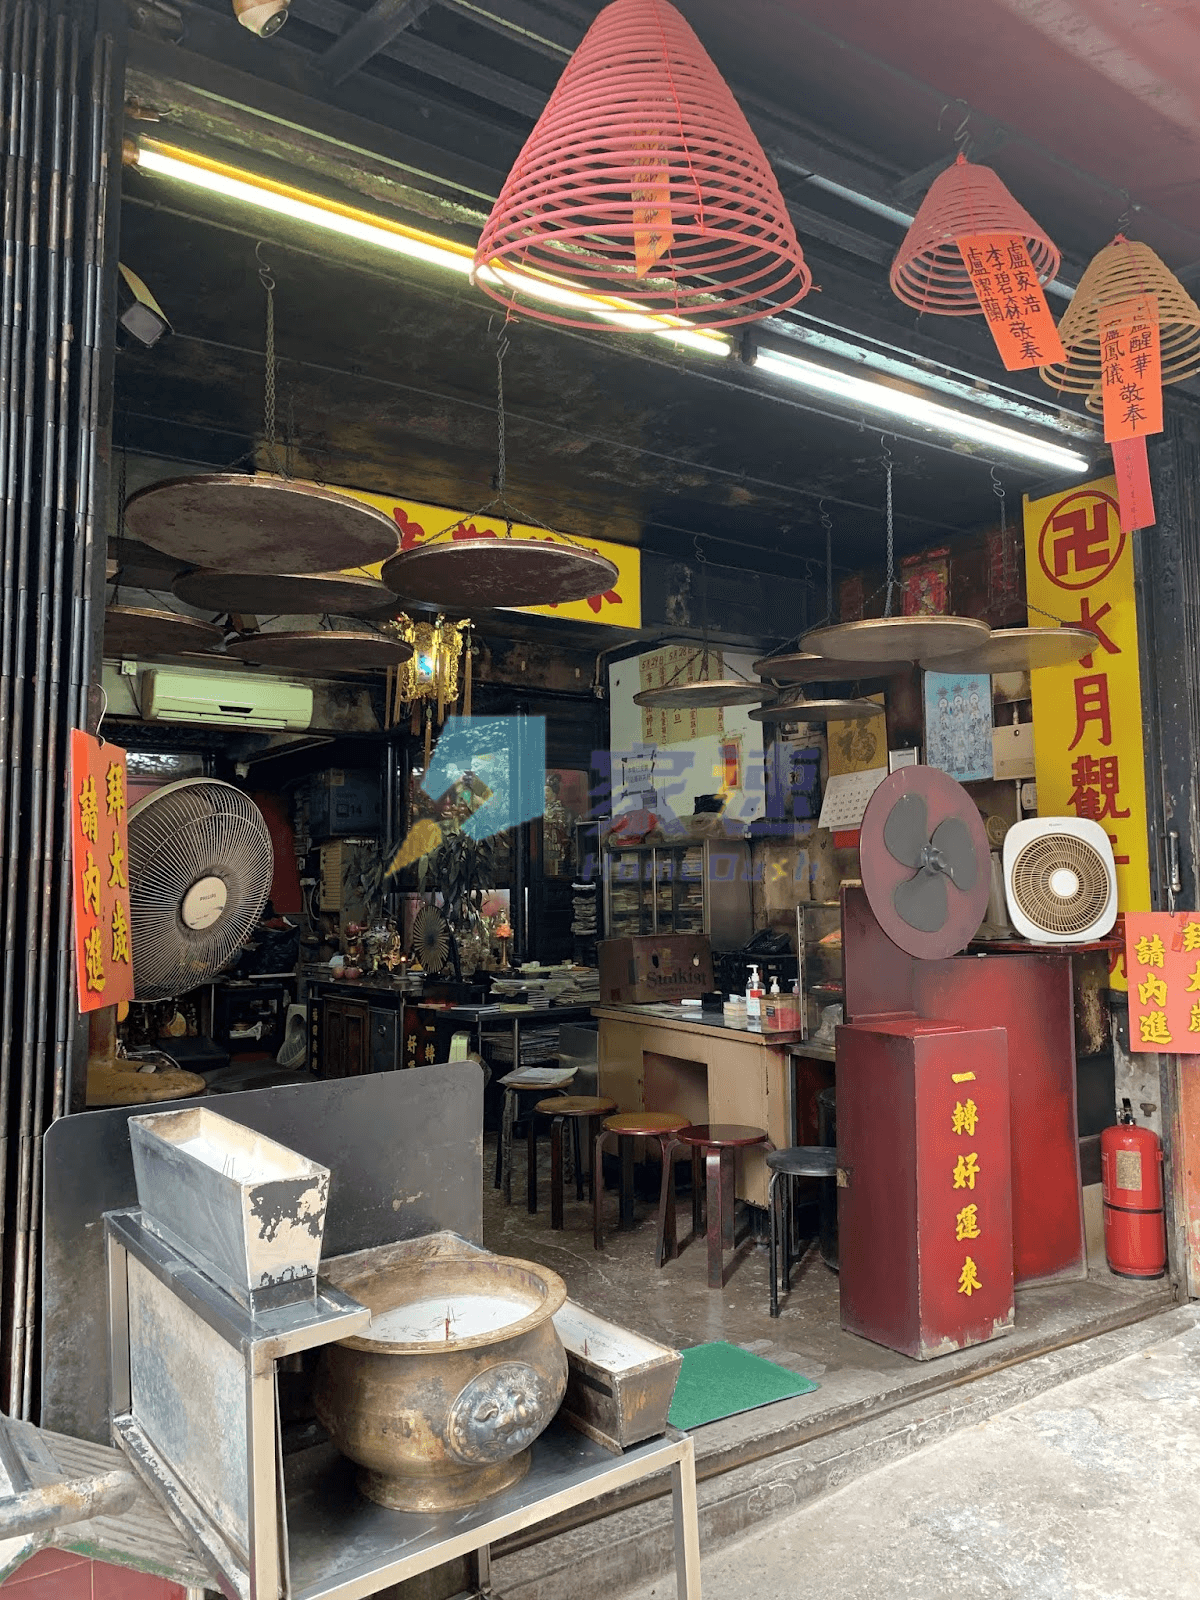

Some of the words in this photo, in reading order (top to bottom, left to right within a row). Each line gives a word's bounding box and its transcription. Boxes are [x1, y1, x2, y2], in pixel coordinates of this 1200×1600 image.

[1009, 320, 1044, 365] 敬奉
[1119, 382, 1148, 432] 敬奉
[1061, 597, 1131, 977] 水月觀
[646, 966, 707, 989] Sunkist
[1134, 933, 1173, 1045] 請內進
[951, 1070, 983, 1297] 一轉好運來
